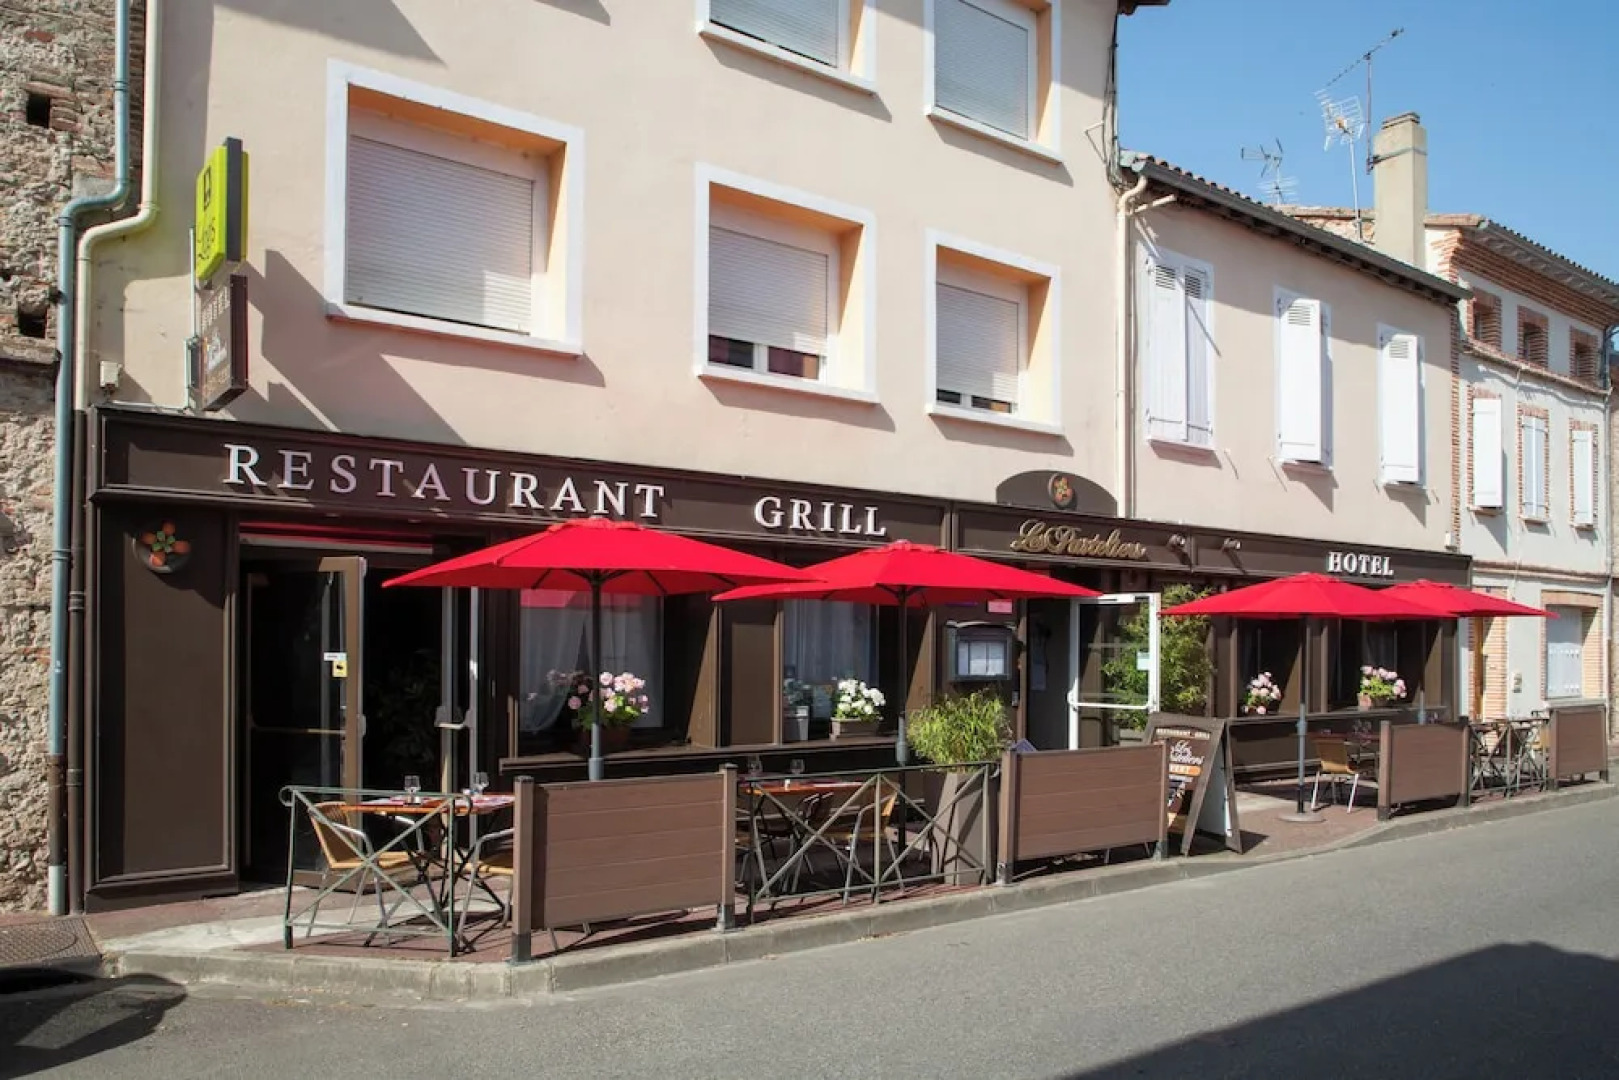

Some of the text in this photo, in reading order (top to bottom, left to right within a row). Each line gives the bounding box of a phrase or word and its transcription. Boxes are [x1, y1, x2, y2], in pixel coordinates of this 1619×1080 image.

[223, 443, 886, 536] RESTAURANT GRILL
[1327, 551, 1395, 576] HOTEL
